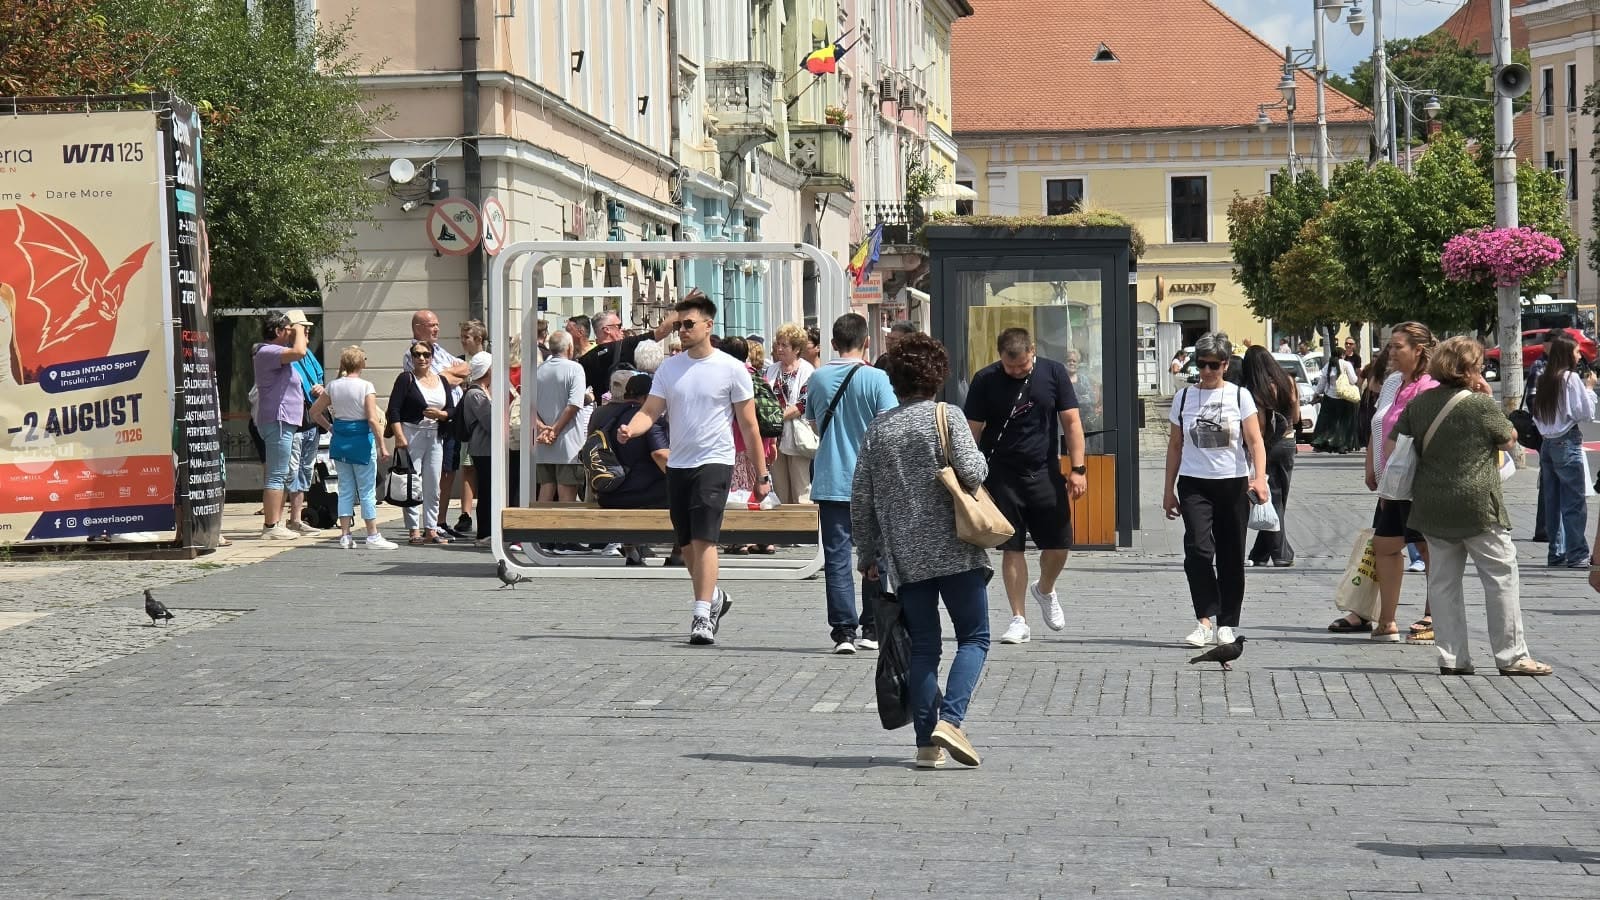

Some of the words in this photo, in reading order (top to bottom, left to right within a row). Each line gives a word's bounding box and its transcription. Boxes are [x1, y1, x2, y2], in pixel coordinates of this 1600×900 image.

[62, 143, 114, 164] WTA
[117, 142, 144, 162] 125
[46, 190, 77, 199] Dare
[80, 189, 113, 198] More
[1168, 282, 1217, 293] AMANET
[60, 369, 81, 378] Baza
[82, 364, 113, 374] INTARO
[114, 360, 137, 371] Sport
[60, 378, 90, 387] Insulei,
[44, 393, 143, 437] AUGUST
[115, 428, 143, 445] 2026
[82, 514, 144, 527] @axeriaopen
